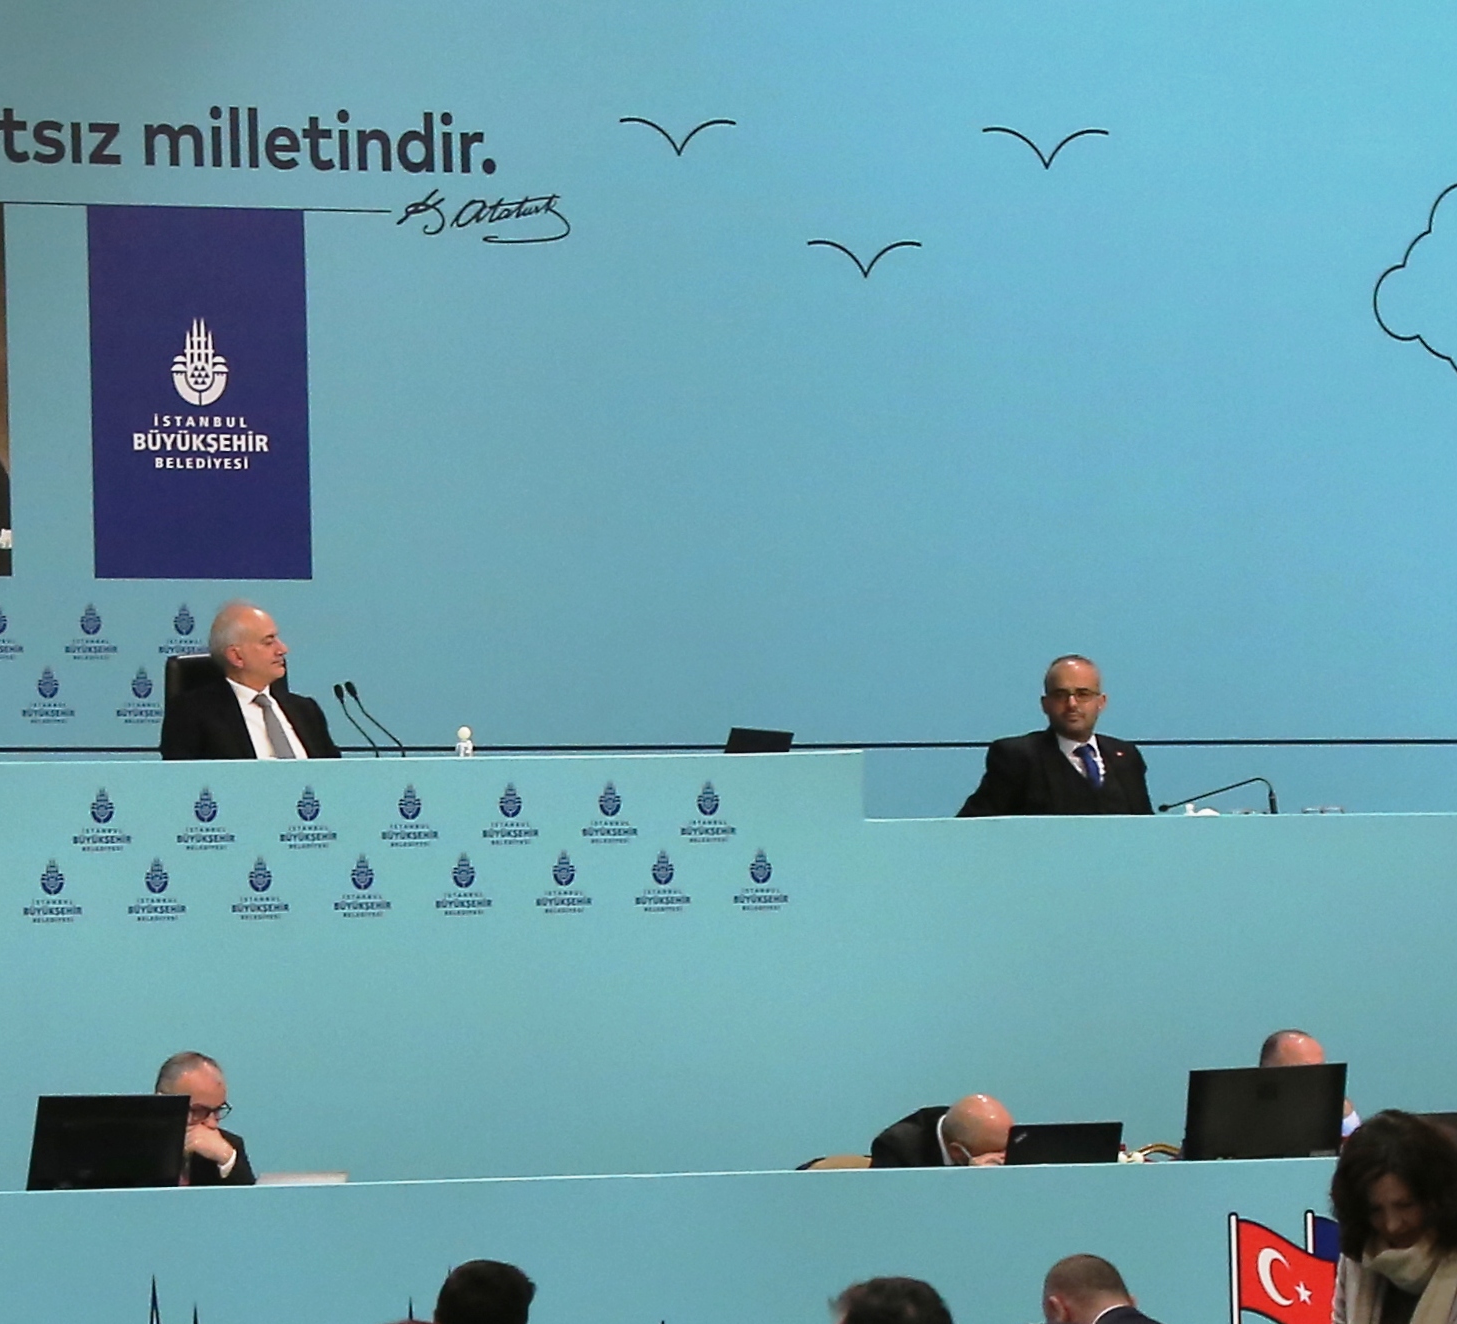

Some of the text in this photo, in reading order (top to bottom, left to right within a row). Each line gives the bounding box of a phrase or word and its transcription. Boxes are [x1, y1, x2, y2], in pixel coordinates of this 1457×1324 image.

[144, 105, 497, 176] milletindir.
[153, 413, 248, 428] İSTANBUL
[132, 429, 269, 453] BÜYÜKŞEHİR
[154, 456, 249, 470] BELEDİYESİ
